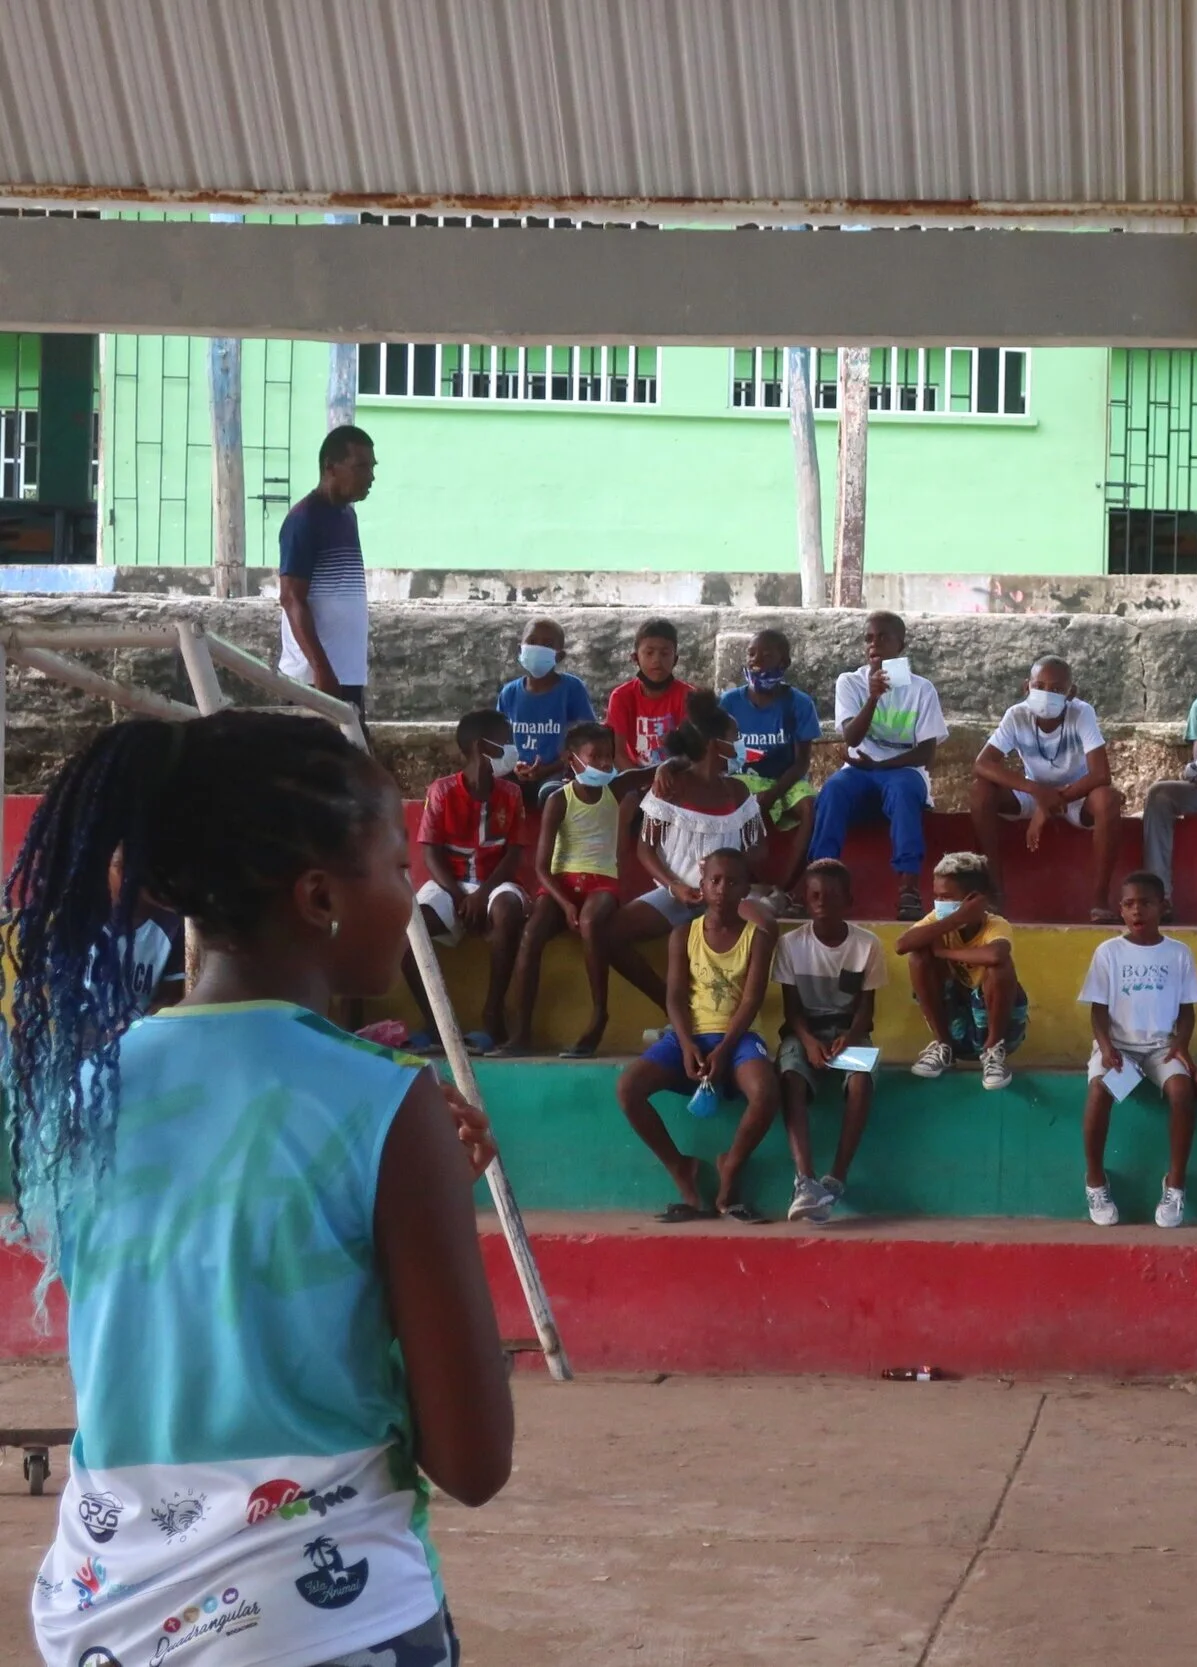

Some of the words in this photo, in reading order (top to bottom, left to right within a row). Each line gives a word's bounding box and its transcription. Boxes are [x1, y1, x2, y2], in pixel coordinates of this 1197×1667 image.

[511, 719, 561, 734] rmando
[738, 728, 787, 745] rmand
[1122, 965, 1169, 978] BOSS
[149, 1599, 261, 1667] Quadrangular
